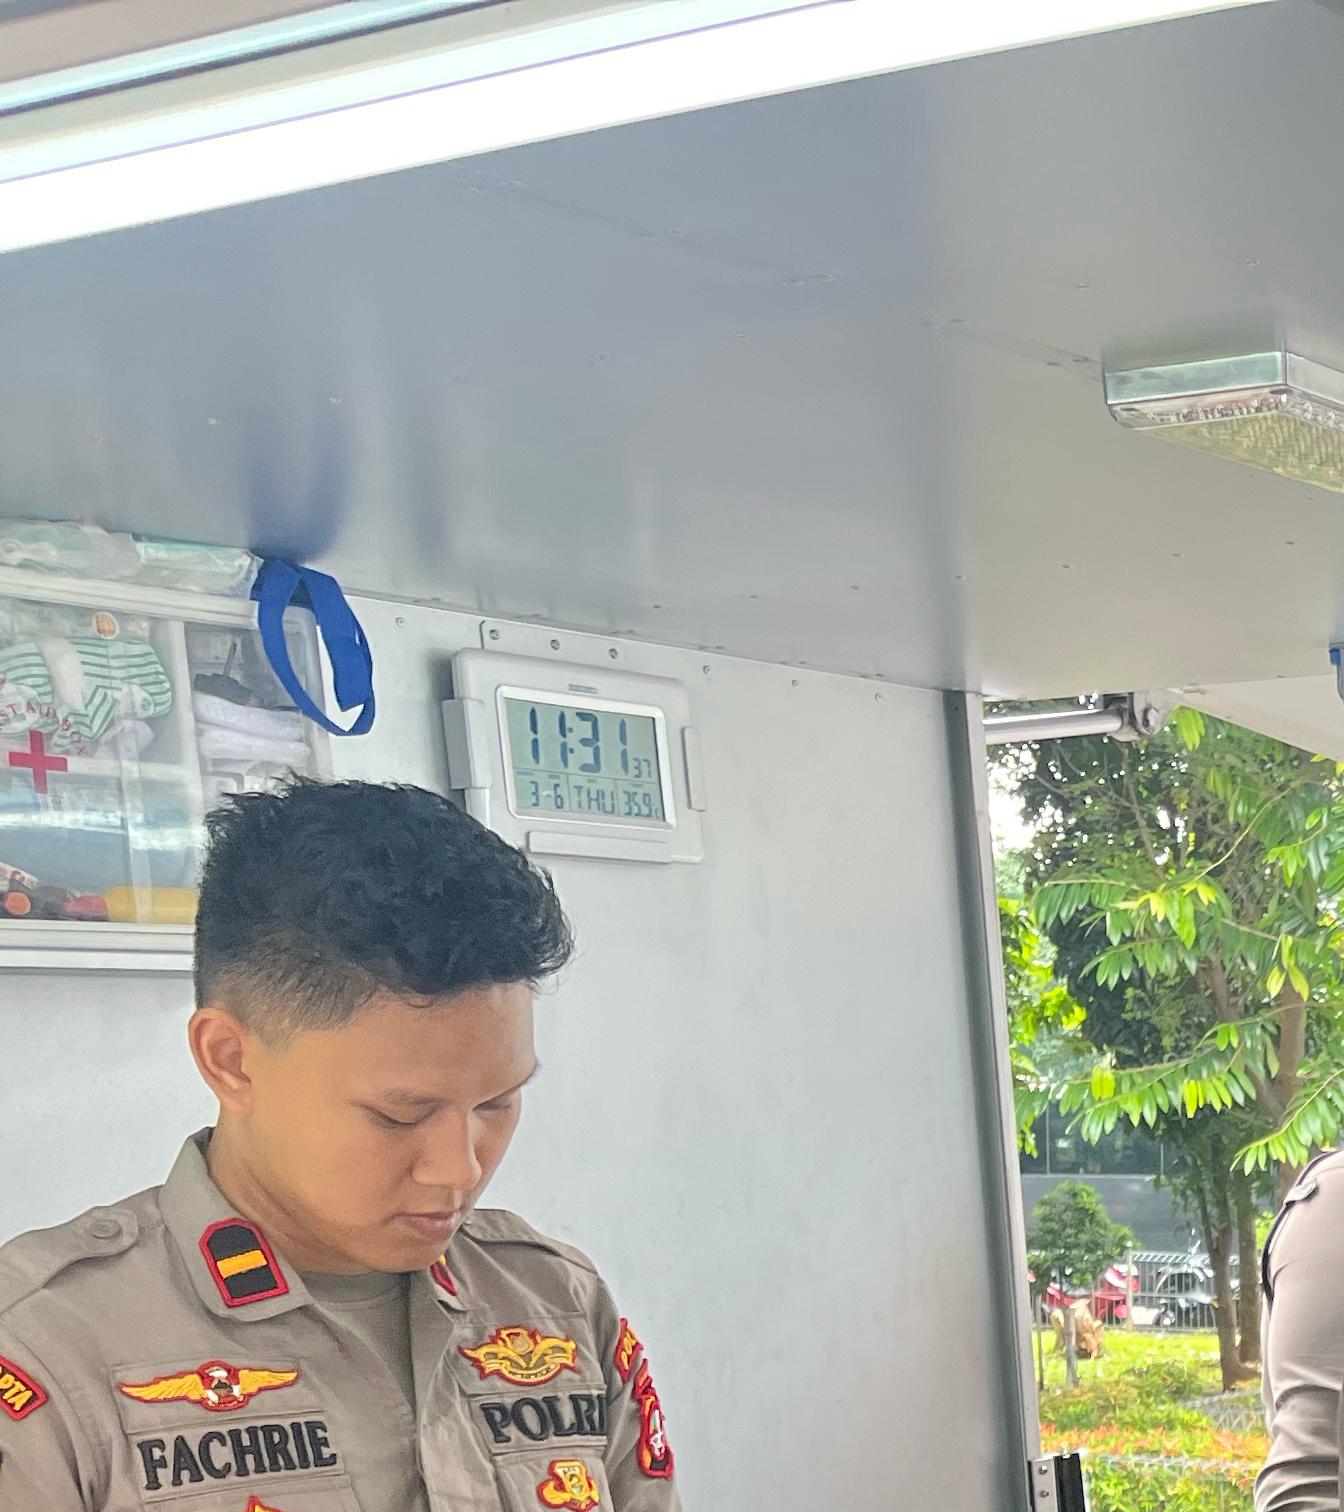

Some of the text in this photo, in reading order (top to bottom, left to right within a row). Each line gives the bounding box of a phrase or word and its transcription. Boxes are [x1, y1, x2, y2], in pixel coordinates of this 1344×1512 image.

[529, 706, 629, 776] 11:31
[632, 757, 652, 779] 37
[573, 784, 616, 815] THU
[137, 1420, 337, 1491] FACHRIE
